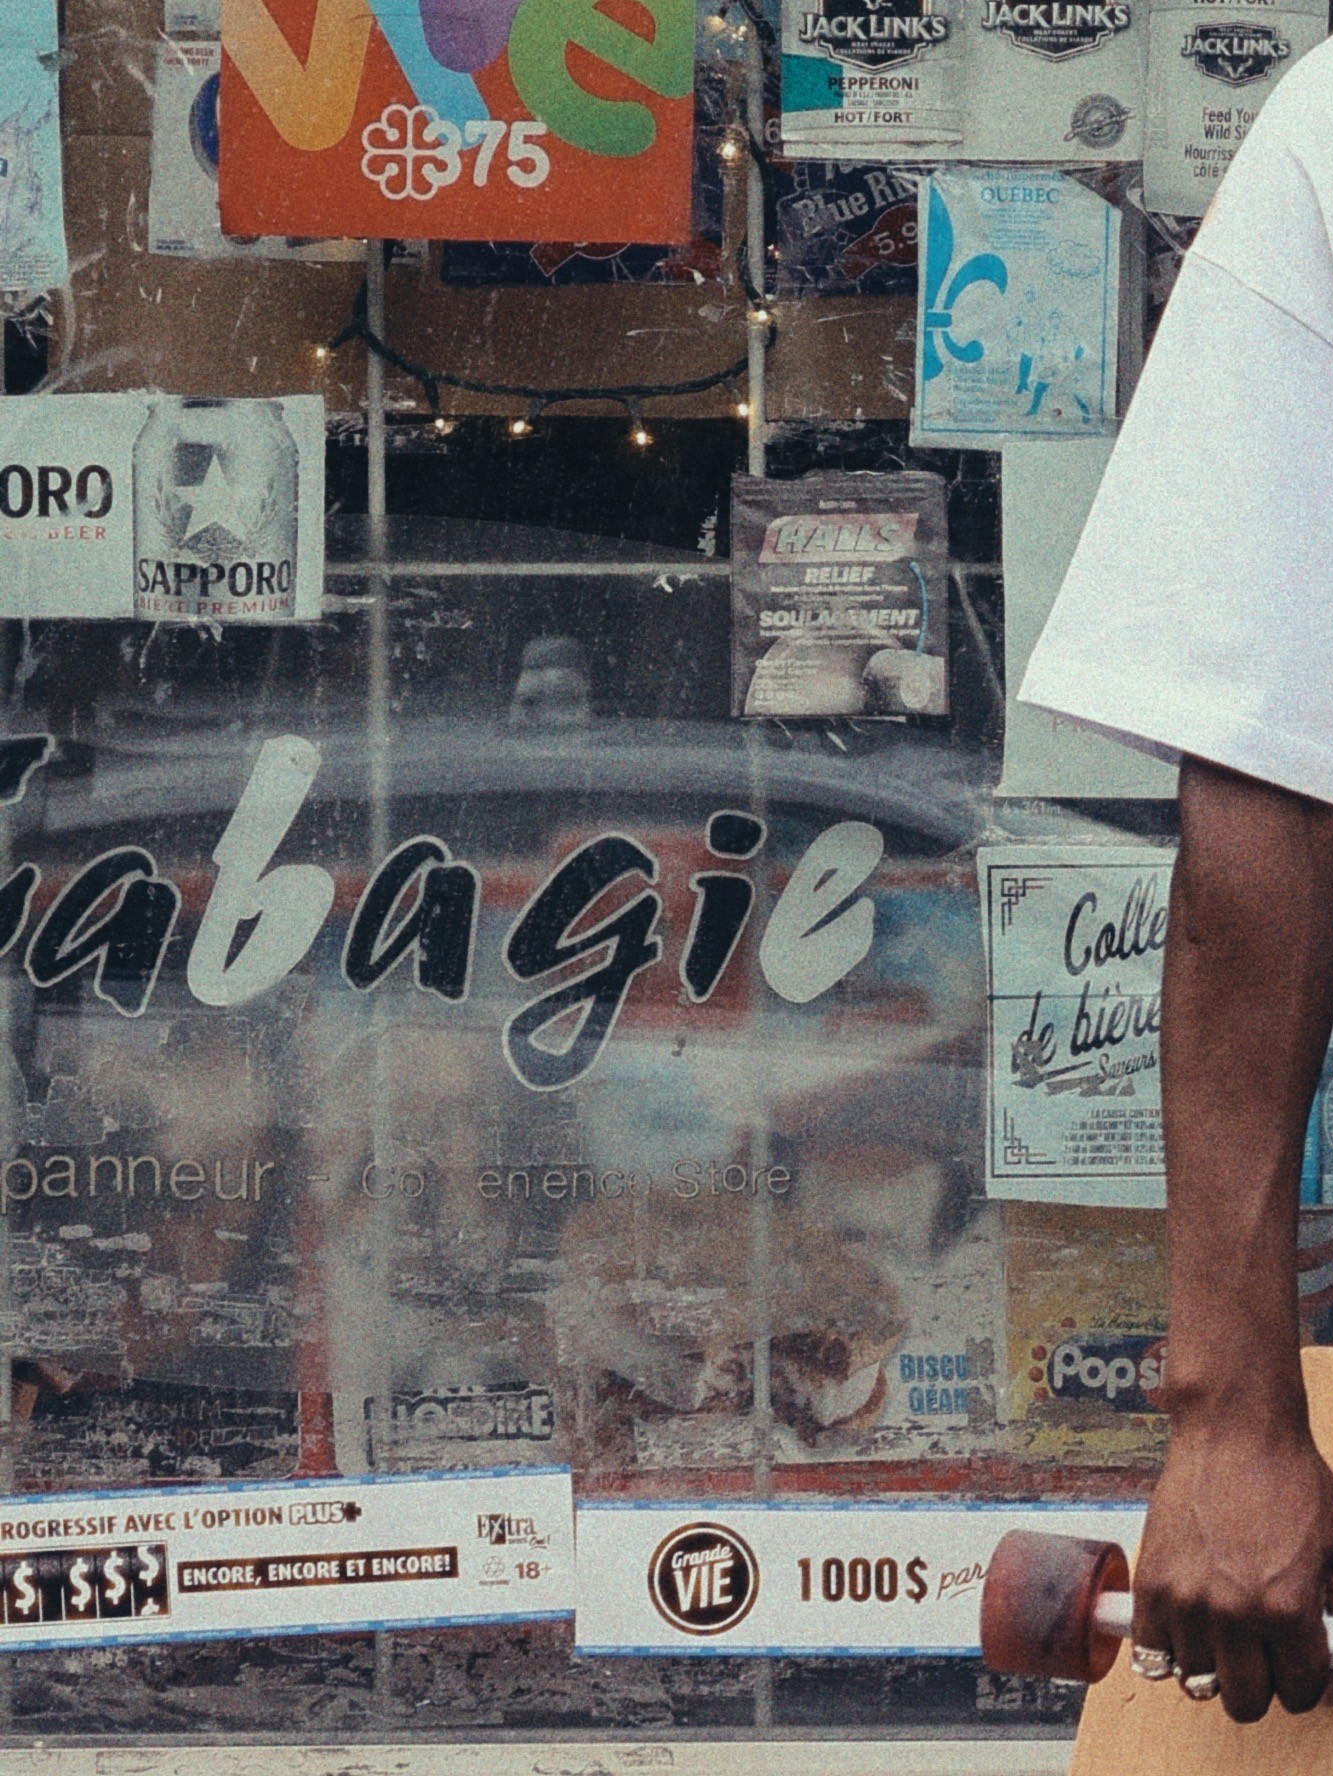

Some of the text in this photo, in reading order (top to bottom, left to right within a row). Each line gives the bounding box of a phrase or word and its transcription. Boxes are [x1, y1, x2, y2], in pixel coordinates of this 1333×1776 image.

[799, 13, 947, 41] JACK LINK'S
[981, 0, 1131, 28] JACK LINK'S
[1182, 34, 1290, 57] JACK LINK'S
[827, 77, 920, 91] PEPPERONI
[833, 111, 913, 124] HOT/FORT
[1201, 107, 1232, 124] Feed
[1203, 124, 1231, 140] Wild
[1192, 160, 1219, 178] côté
[980, 184, 1060, 206] QUÉBEC
[790, 188, 871, 236] Blue
[775, 523, 901, 554] HALLS
[137, 558, 291, 597] SAPPORO
[804, 565, 876, 584] RELIEF
[195, 596, 289, 615] PREMIUM
[759, 608, 920, 627] SOULAGEMENT
[1011, 990, 1056, 1075] de
[671, 1156, 793, 1201] Store
[124, 1512, 177, 1534] AVEC
[183, 1506, 284, 1531] L'OPTION
[476, 1512, 538, 1546] Extra
[183, 1552, 451, 1587] ENCORE, ENCORE ET ENCORE!
[515, 1561, 552, 1580] 18+
[670, 1543, 734, 1573] Grande
[670, 1561, 734, 1615] VIE
